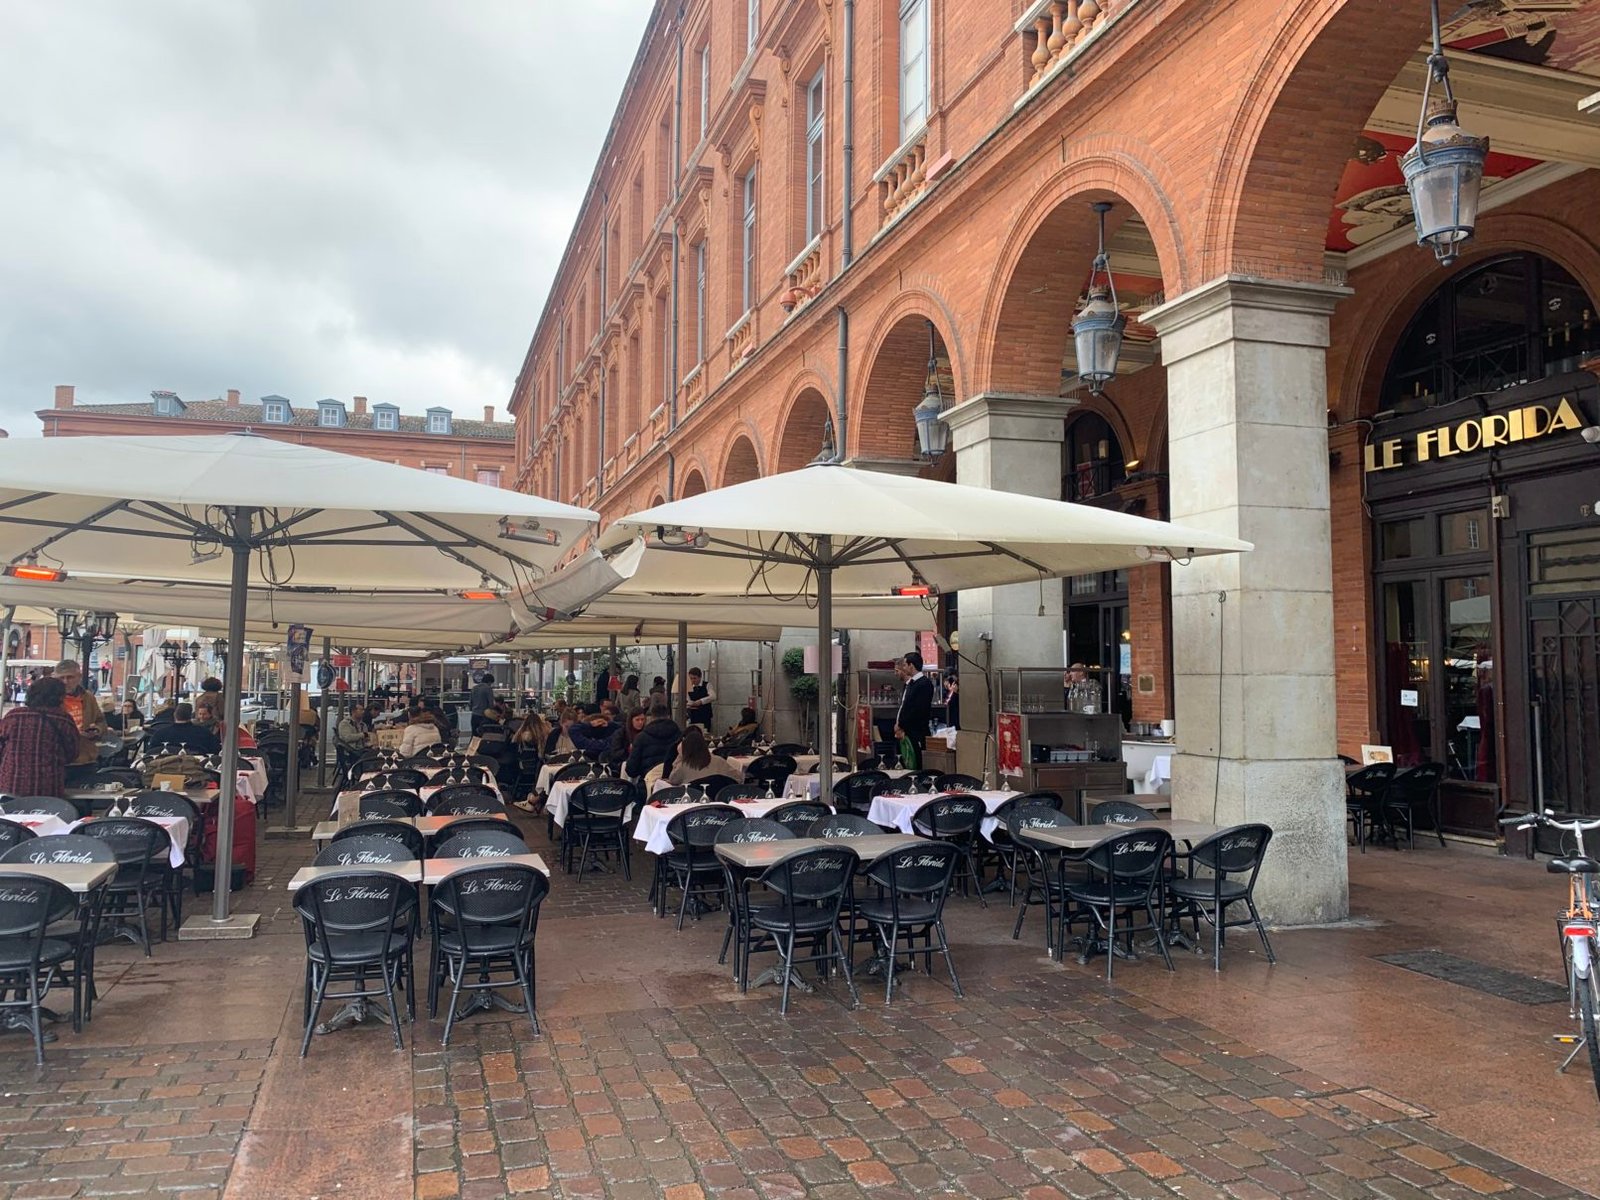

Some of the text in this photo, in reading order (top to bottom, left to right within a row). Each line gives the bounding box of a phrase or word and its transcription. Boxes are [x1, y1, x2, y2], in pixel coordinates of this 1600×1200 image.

[1365, 396, 1583, 473] LE FLORIDA
[142, 805, 174, 818] Florida
[781, 811, 793, 822] Le
[937, 804, 974, 817] Le Florida
[686, 816, 700, 827] Le
[111, 825, 149, 837] Florida
[1113, 841, 1157, 855] Le Florida
[30, 849, 94, 865] Le Florida
[337, 852, 352, 866] Le
[896, 854, 945, 869] Le Florida
[792, 857, 843, 875] Le Florida
[460, 877, 524, 895] Le Florida
[323, 886, 390, 903] Le Florida
